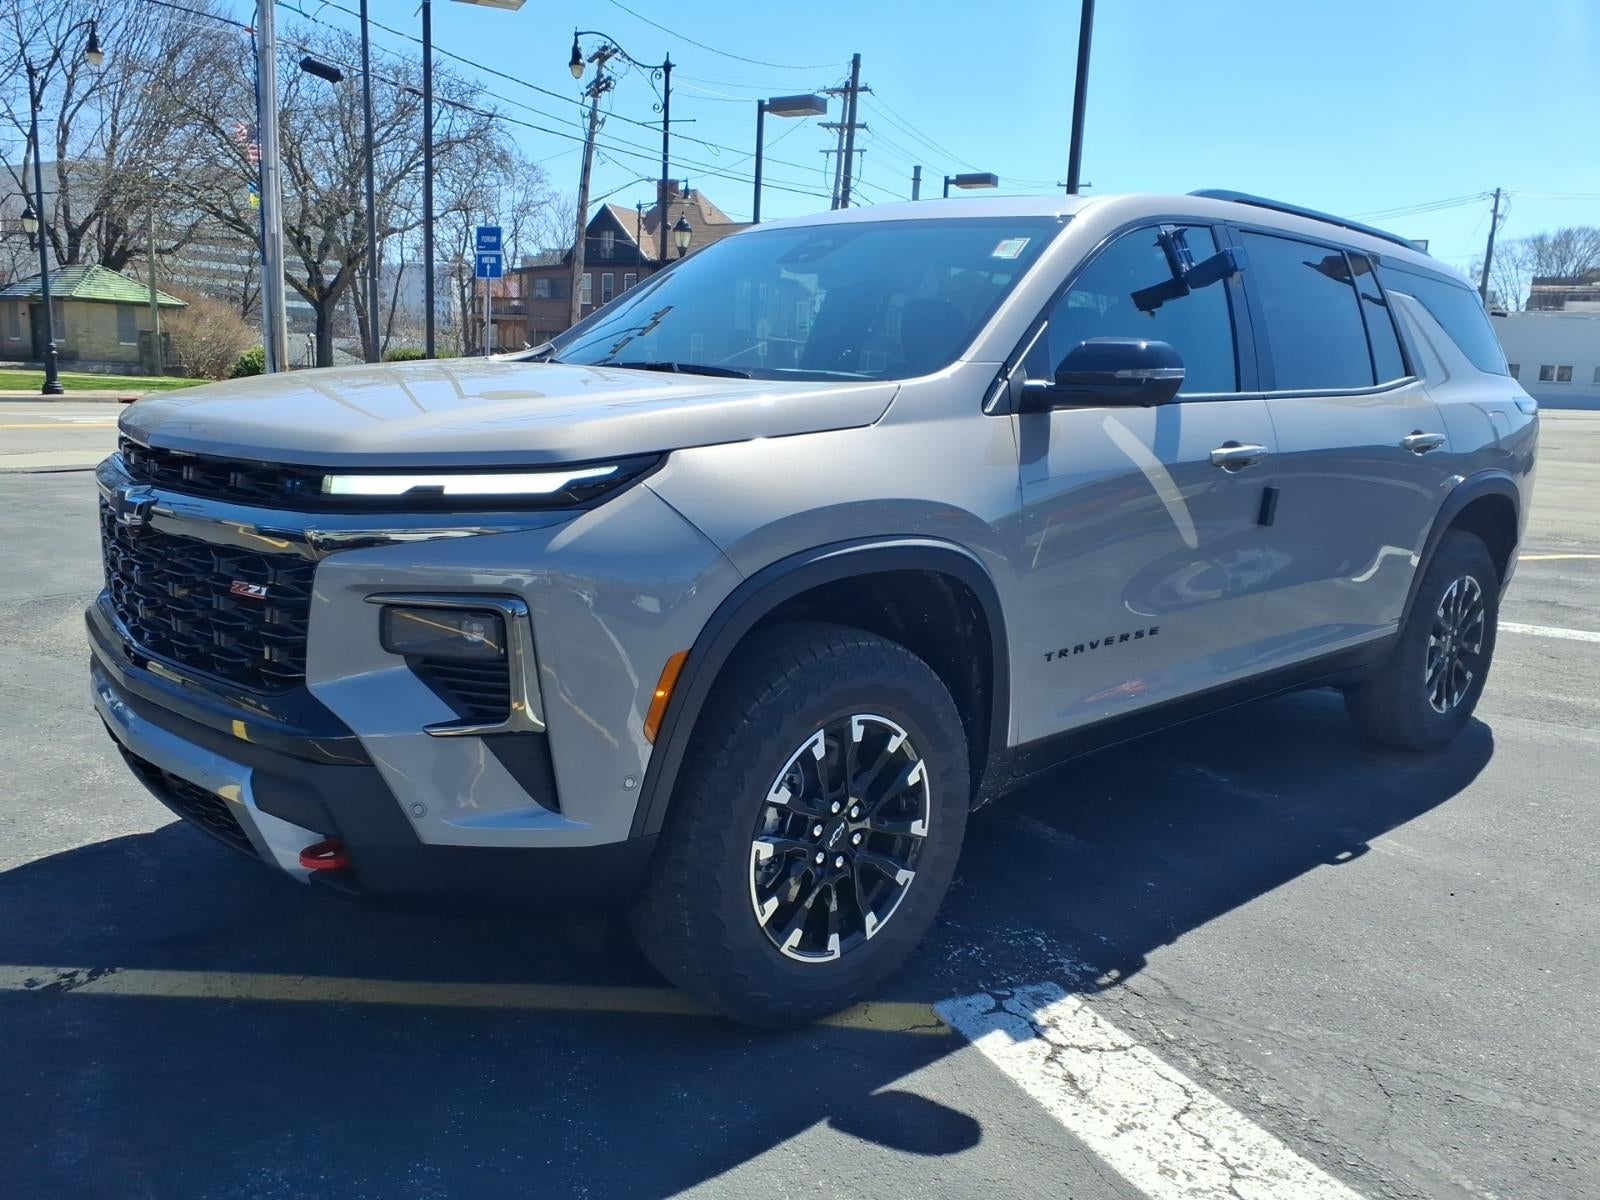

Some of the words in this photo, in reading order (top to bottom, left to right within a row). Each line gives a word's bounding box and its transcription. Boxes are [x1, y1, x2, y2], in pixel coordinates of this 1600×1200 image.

[480, 235, 497, 243] FORUM
[481, 256, 497, 264] ARENA
[231, 580, 267, 600] Z71
[1043, 626, 1161, 662] TRAVERSE
